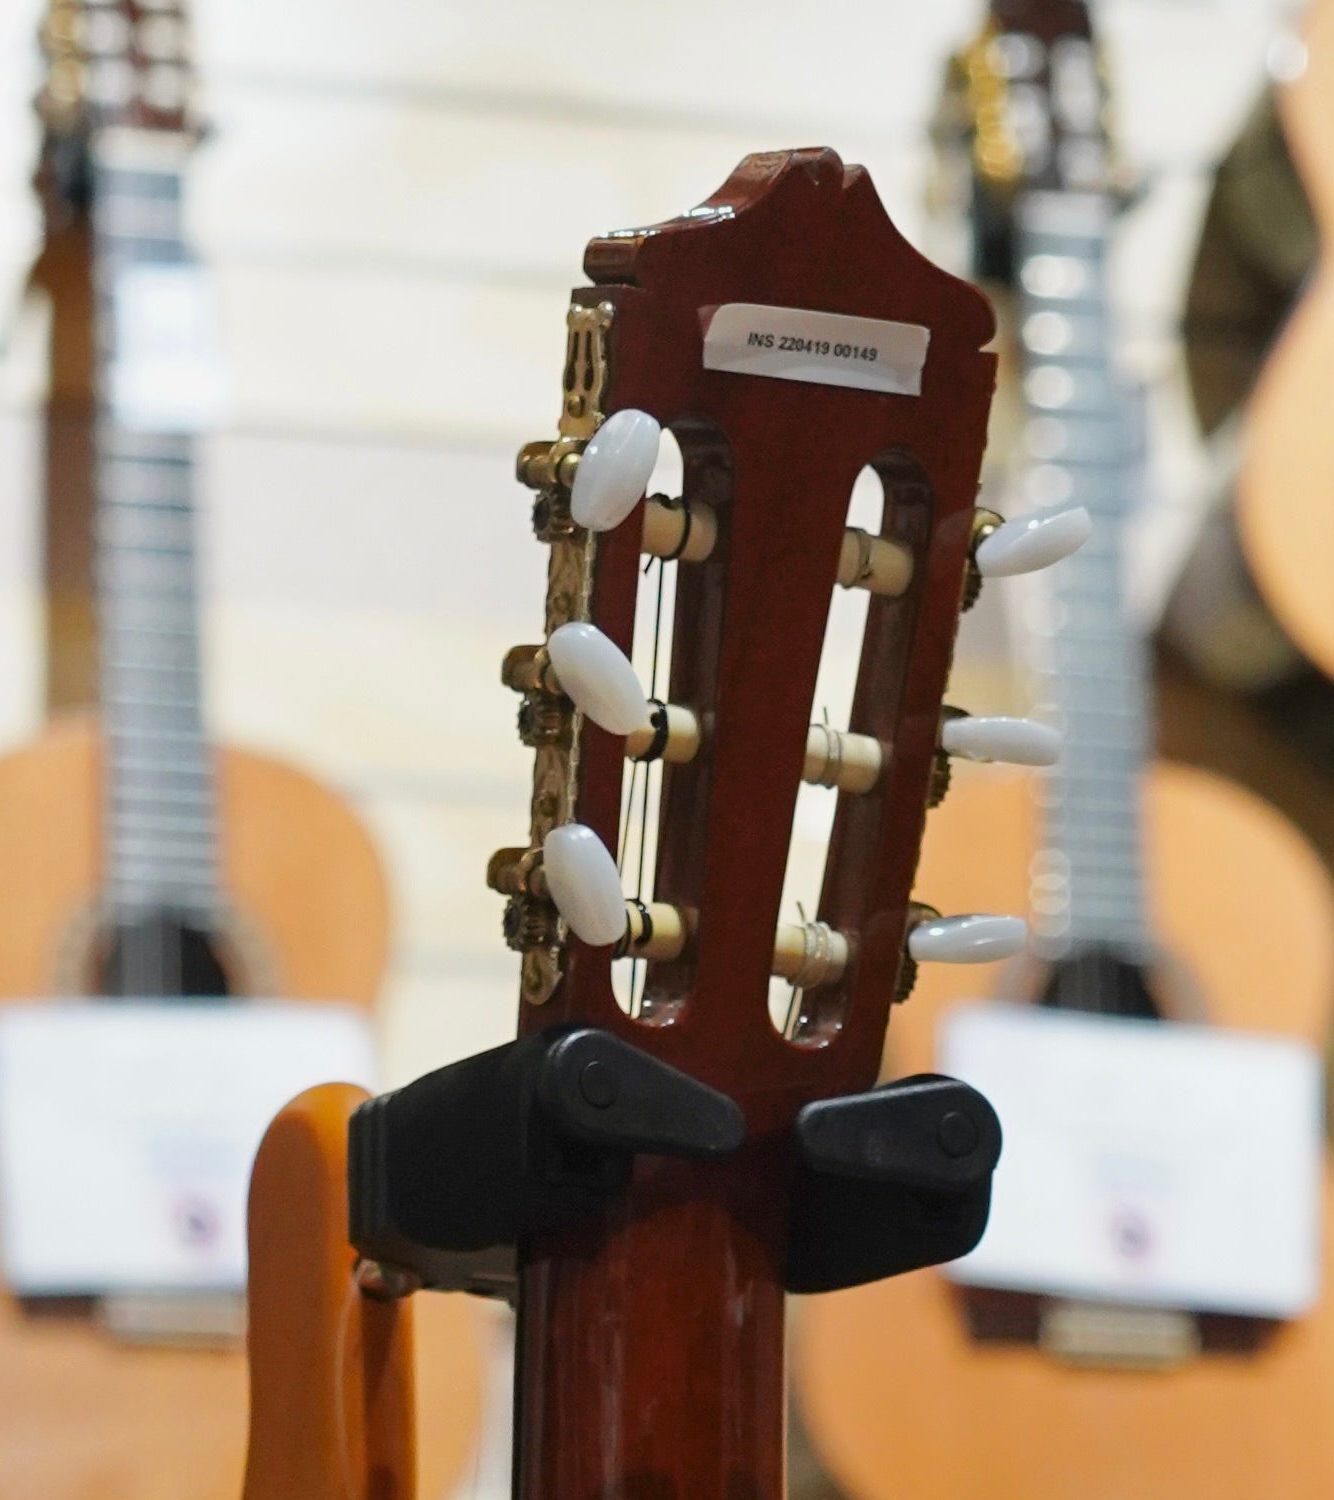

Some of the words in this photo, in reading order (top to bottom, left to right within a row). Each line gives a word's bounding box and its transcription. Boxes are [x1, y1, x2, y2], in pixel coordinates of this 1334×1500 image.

[748, 332, 773, 348] INS
[778, 337, 830, 354] 220419
[834, 345, 877, 361] 00149
